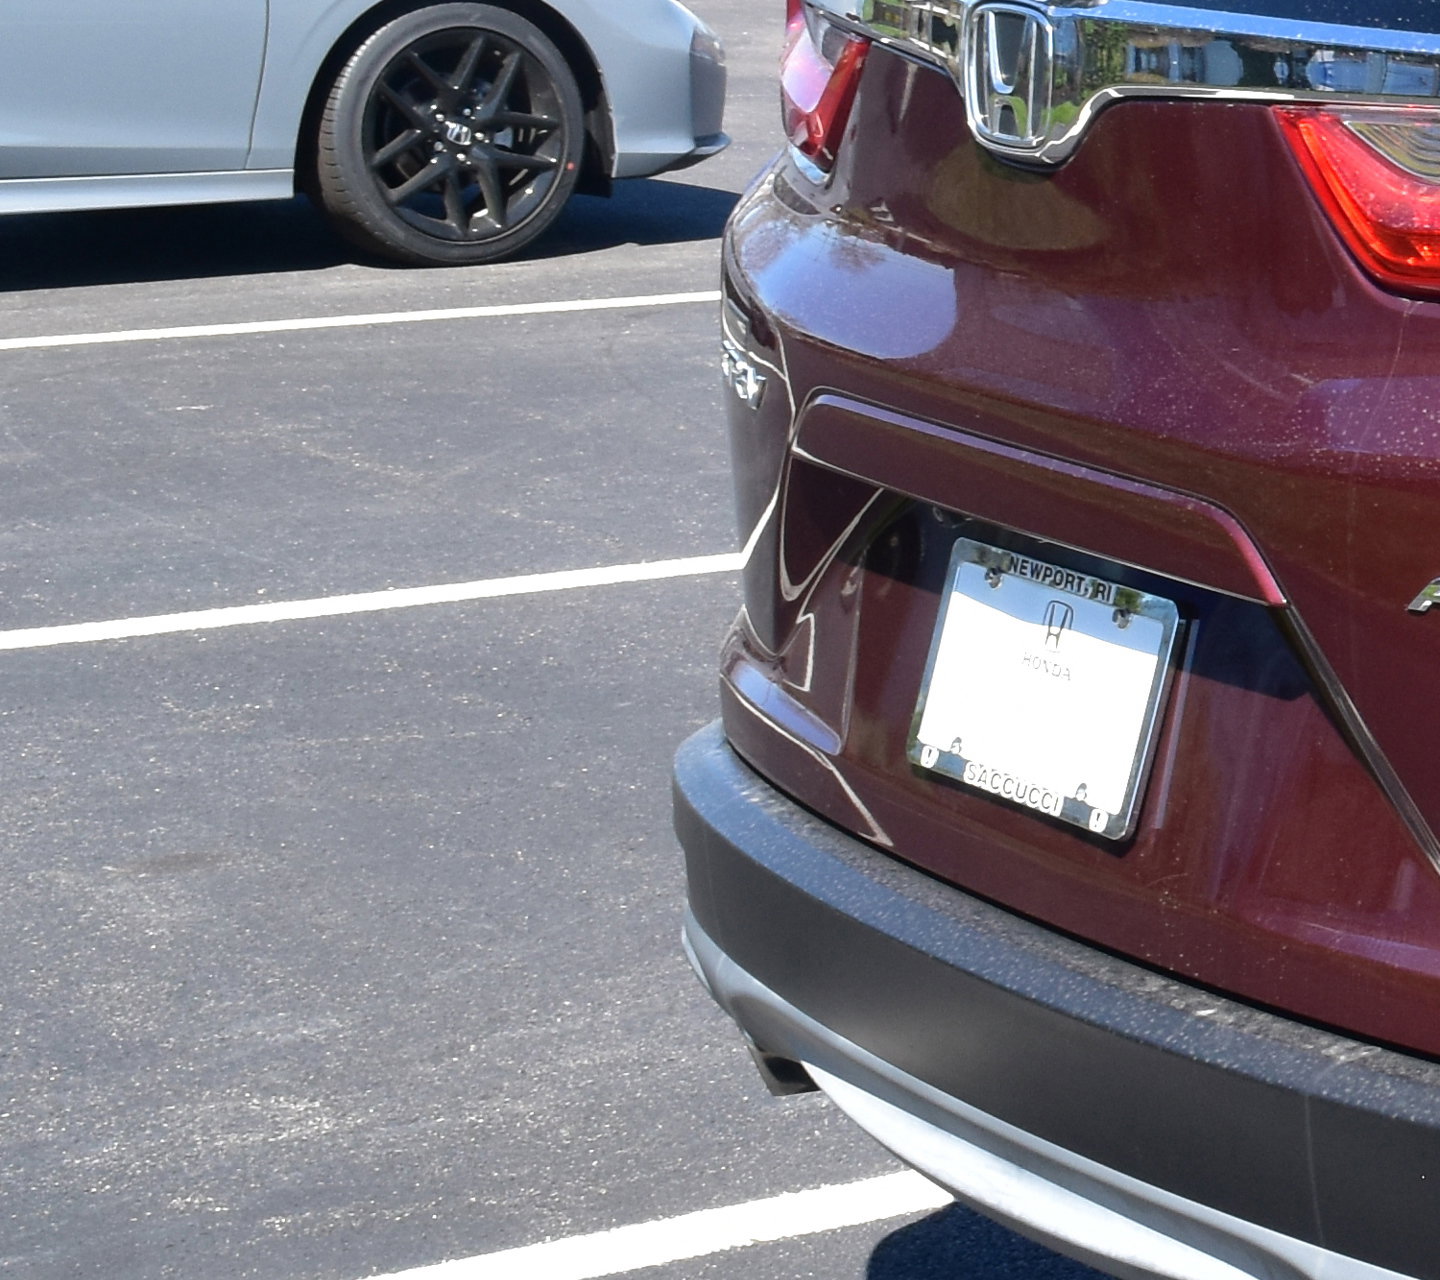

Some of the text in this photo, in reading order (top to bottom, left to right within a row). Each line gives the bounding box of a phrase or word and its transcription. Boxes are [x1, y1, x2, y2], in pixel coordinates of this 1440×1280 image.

[1010, 555, 1113, 602] NEWPORT, RI
[1021, 651, 1073, 681] HONDA
[966, 763, 1061, 814] SACCUCCI
